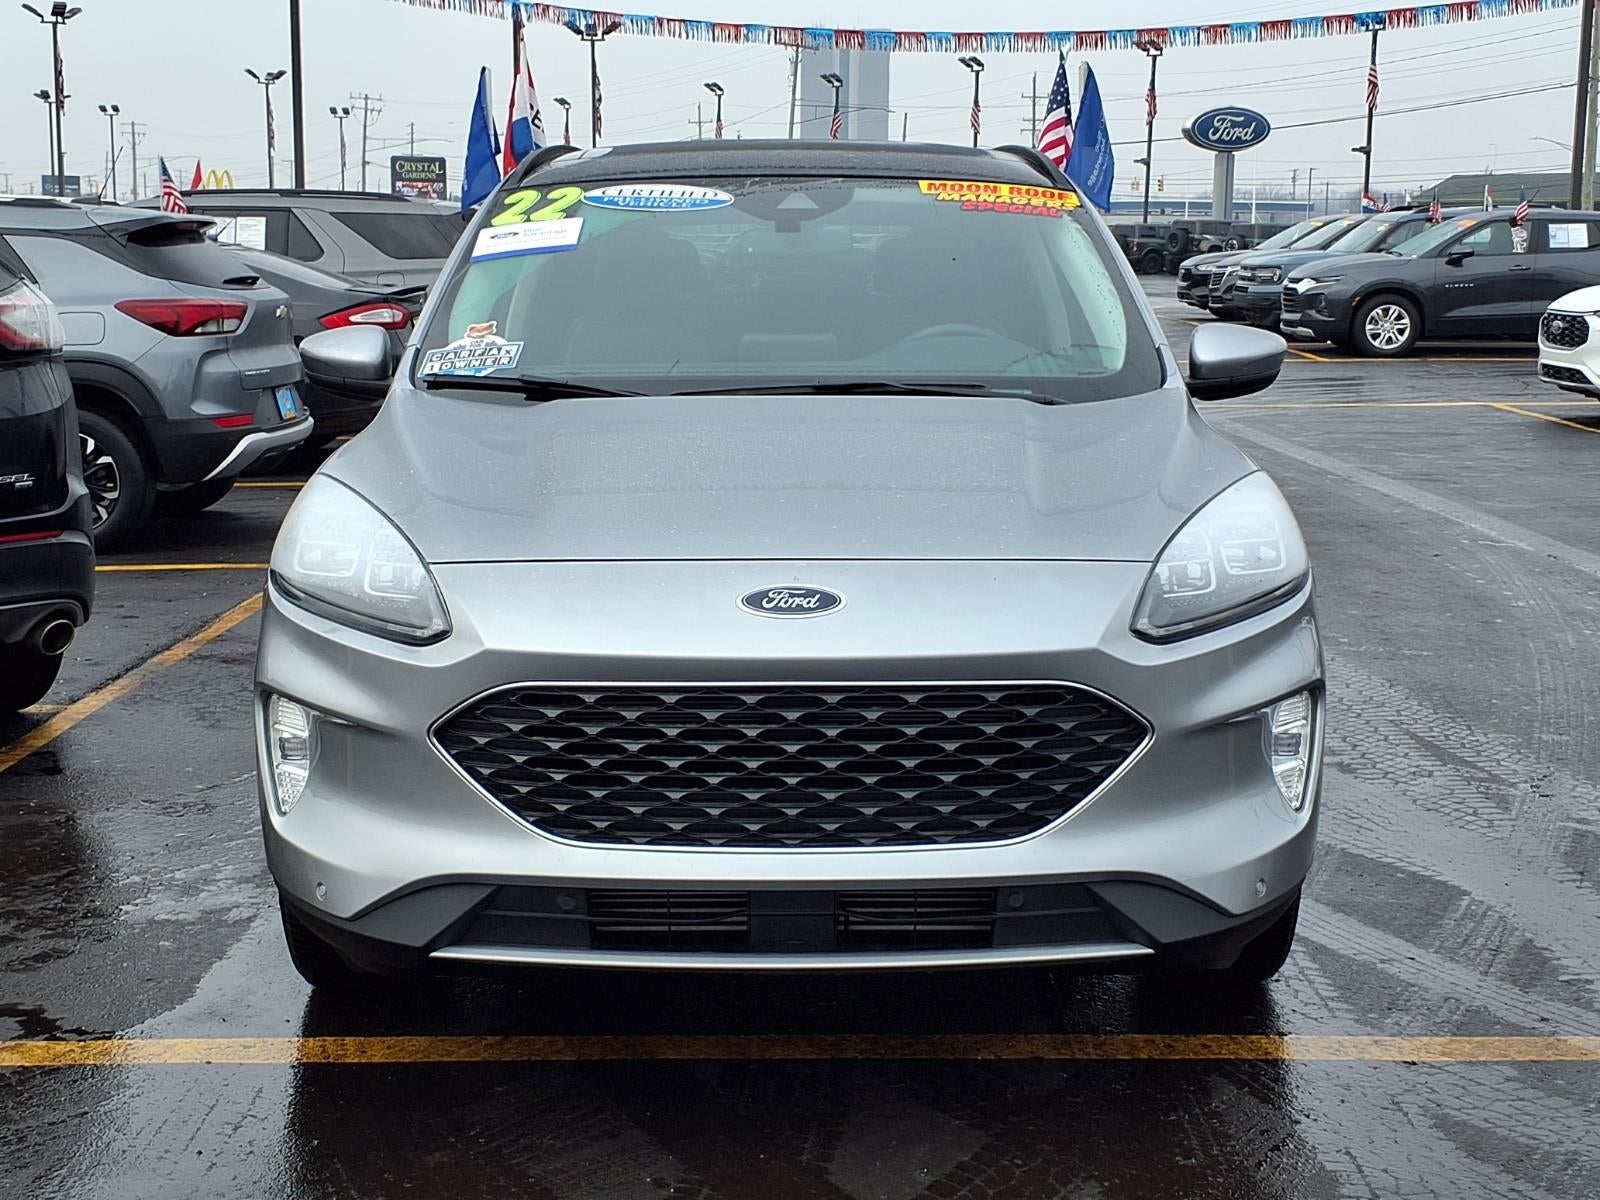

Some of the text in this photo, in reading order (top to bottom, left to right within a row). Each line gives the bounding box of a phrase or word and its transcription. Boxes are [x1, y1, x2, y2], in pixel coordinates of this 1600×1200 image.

[1208, 114, 1256, 140] Ford
[395, 160, 444, 174] CRYSTAL
[402, 171, 437, 179] GARDENS
[602, 188, 719, 198] CERTIFIED
[926, 182, 1074, 201] MOON ROOF
[490, 186, 585, 227] 22
[960, 201, 1063, 218] SPECIAL
[431, 347, 513, 362] CARFAX
[440, 357, 510, 370] OWNER
[762, 589, 821, 609] Ford
